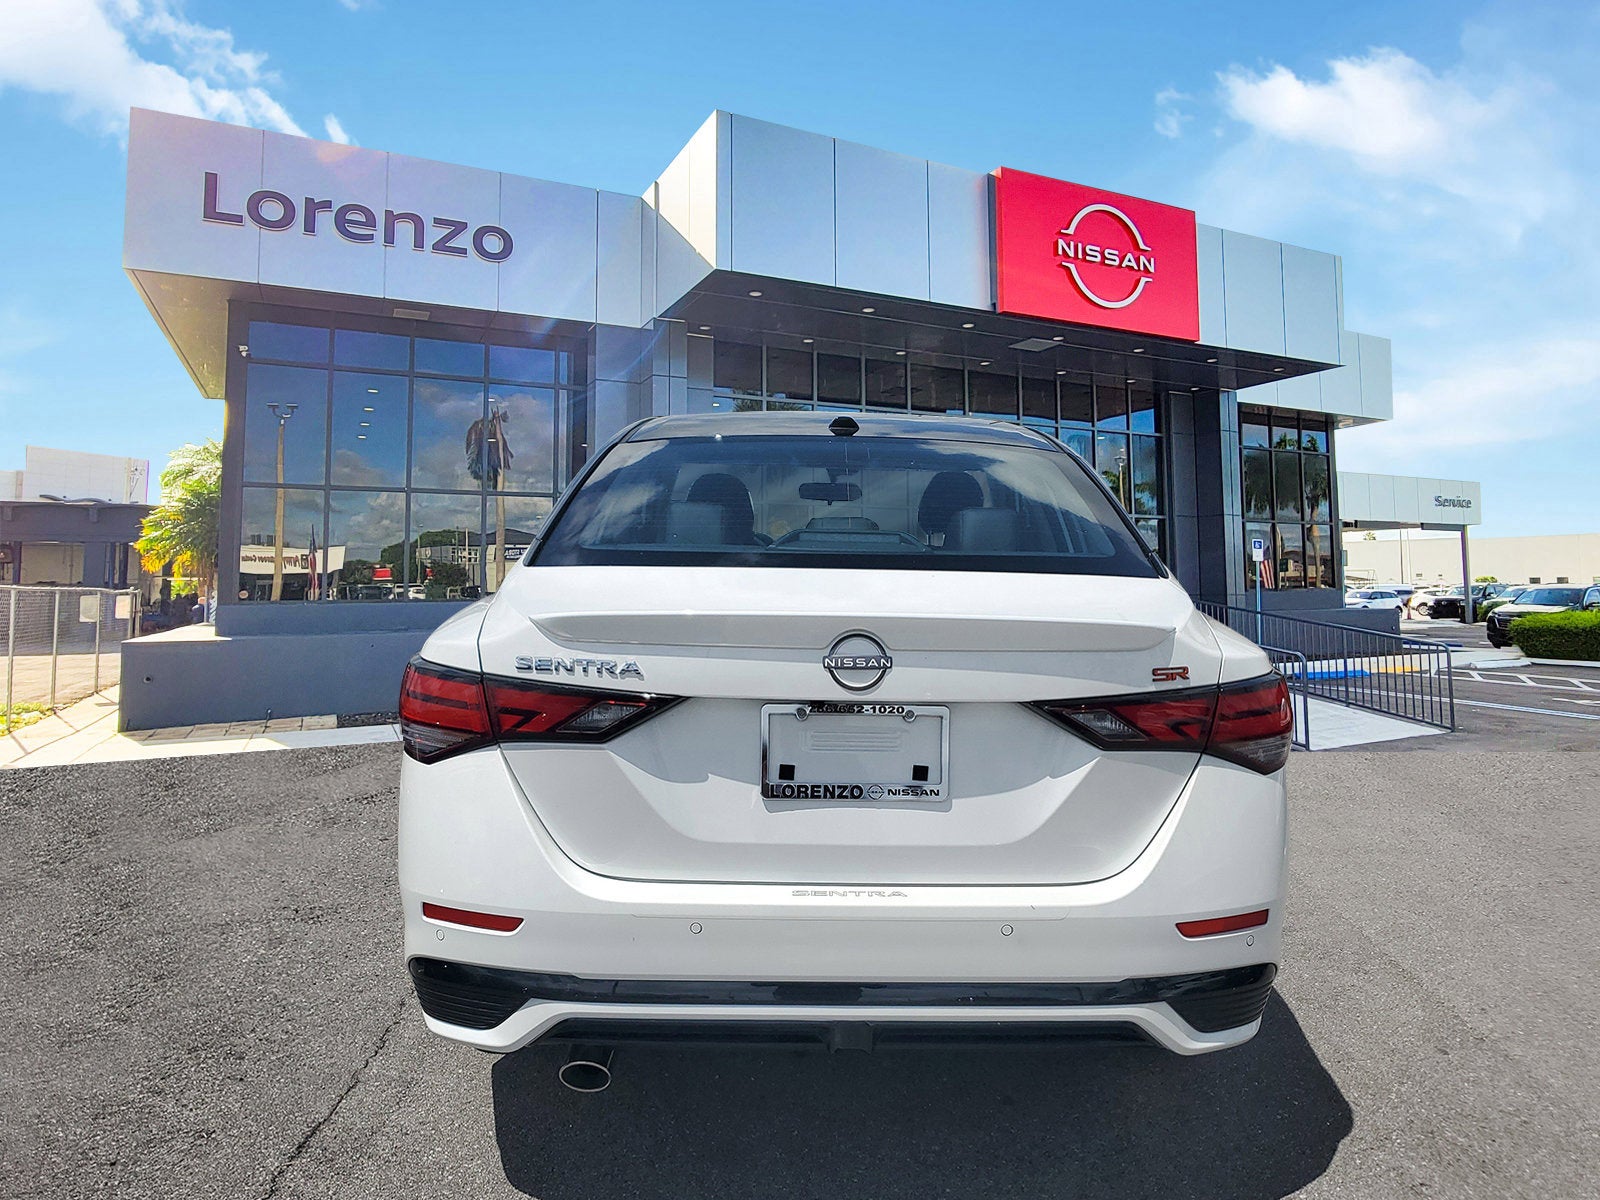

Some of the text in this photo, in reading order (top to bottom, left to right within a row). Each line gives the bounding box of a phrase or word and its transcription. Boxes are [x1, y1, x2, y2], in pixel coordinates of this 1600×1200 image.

[203, 171, 514, 262] Lorenzo
[1057, 238, 1155, 273] NISSAN
[1434, 495, 1472, 509] Service
[515, 655, 645, 681] SENTRA
[824, 658, 891, 667] NISSAN
[1152, 666, 1190, 682] SR
[770, 784, 864, 799] LORENZO
[887, 788, 940, 797] NISSAN
[791, 889, 909, 898] SENTRA
